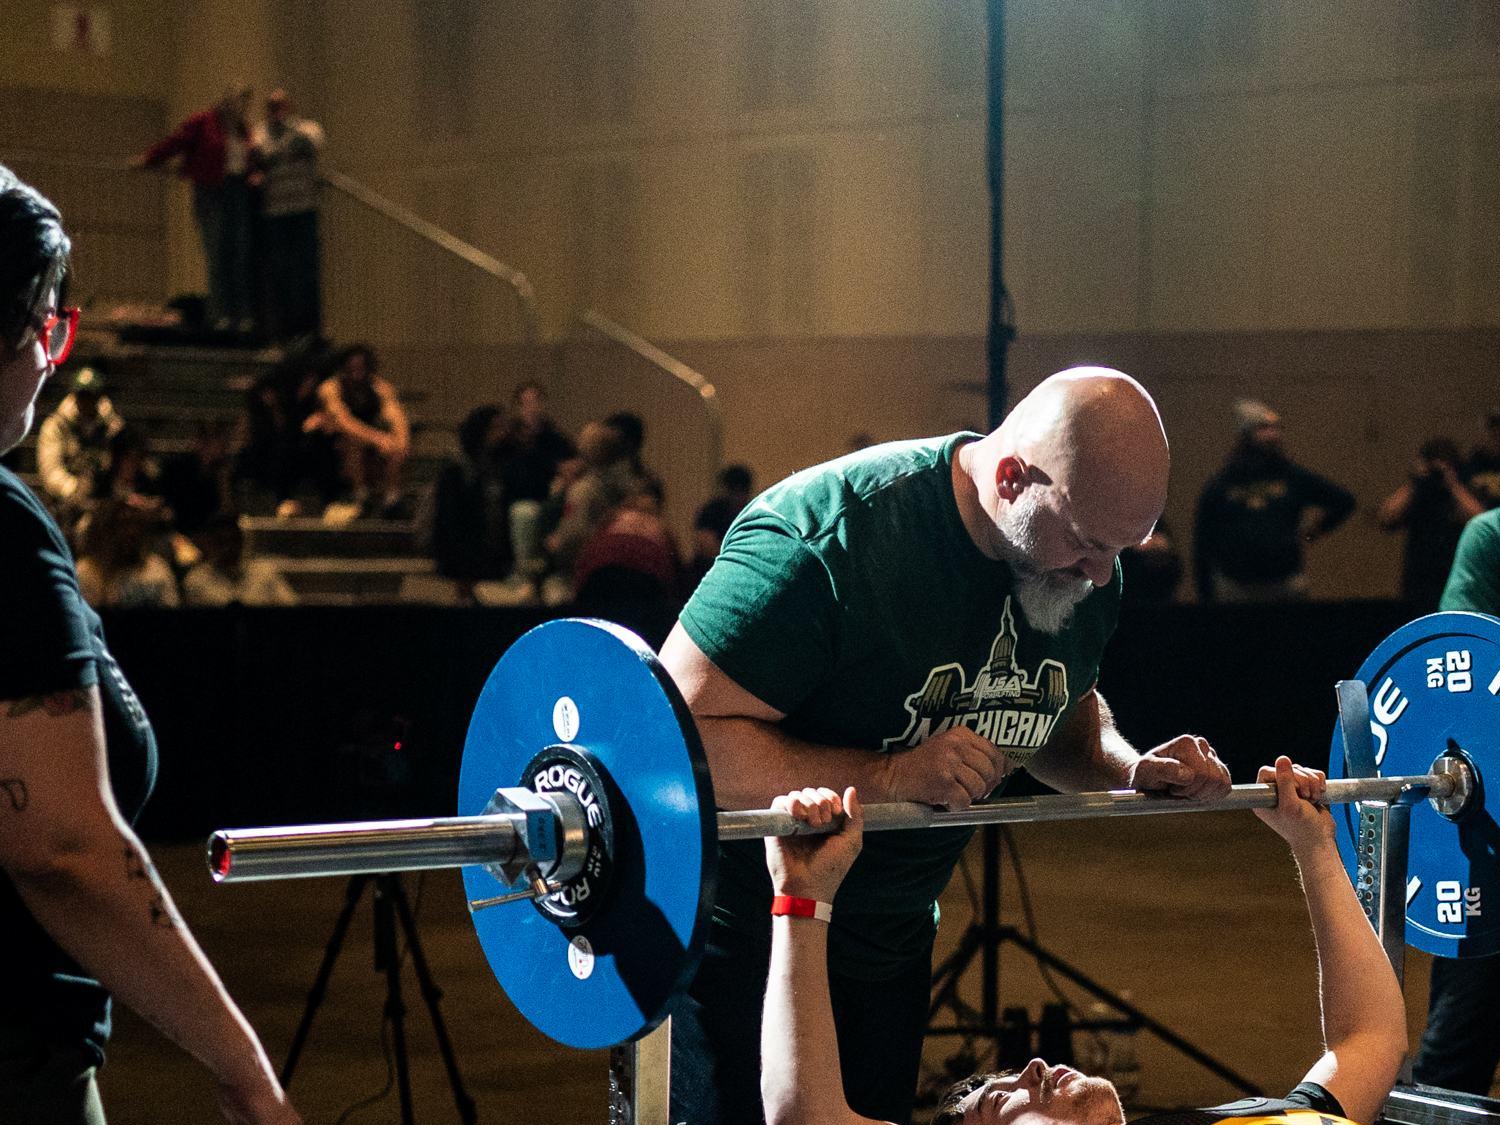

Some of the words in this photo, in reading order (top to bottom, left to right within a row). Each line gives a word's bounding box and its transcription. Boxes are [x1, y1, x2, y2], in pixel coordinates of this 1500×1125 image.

[986, 675, 1021, 690] USA
[1427, 657, 1445, 689] KG
[1446, 649, 1473, 693] 20
[534, 764, 604, 828] ROGUE
[1436, 880, 1464, 924] 20
[1464, 887, 1482, 917] KG
